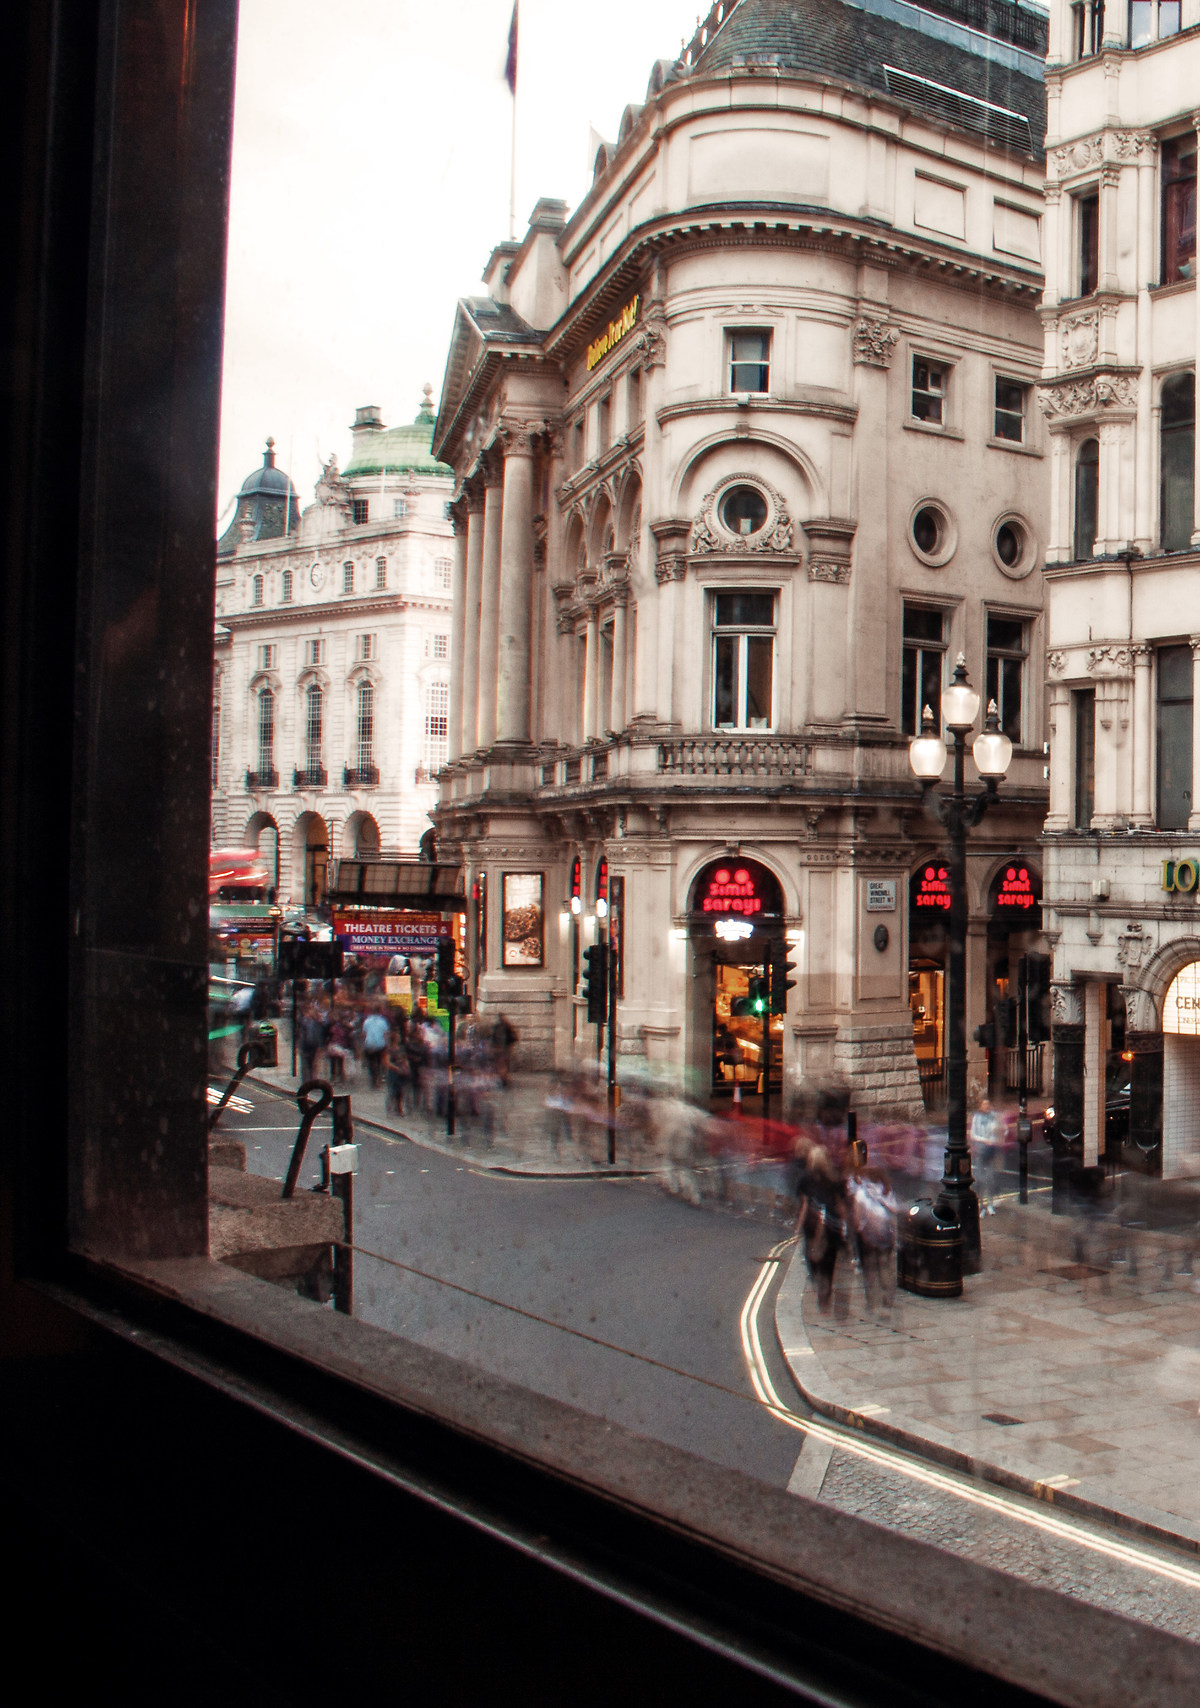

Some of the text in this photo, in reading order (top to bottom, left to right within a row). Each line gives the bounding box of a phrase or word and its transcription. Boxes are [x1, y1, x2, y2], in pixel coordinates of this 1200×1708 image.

[870, 882, 884, 890] GREAT
[870, 896, 886, 904] STREET
[344, 923, 448, 934] THEATRE TICKETS &
[351, 935, 439, 945] MONEY EXCHANGE
